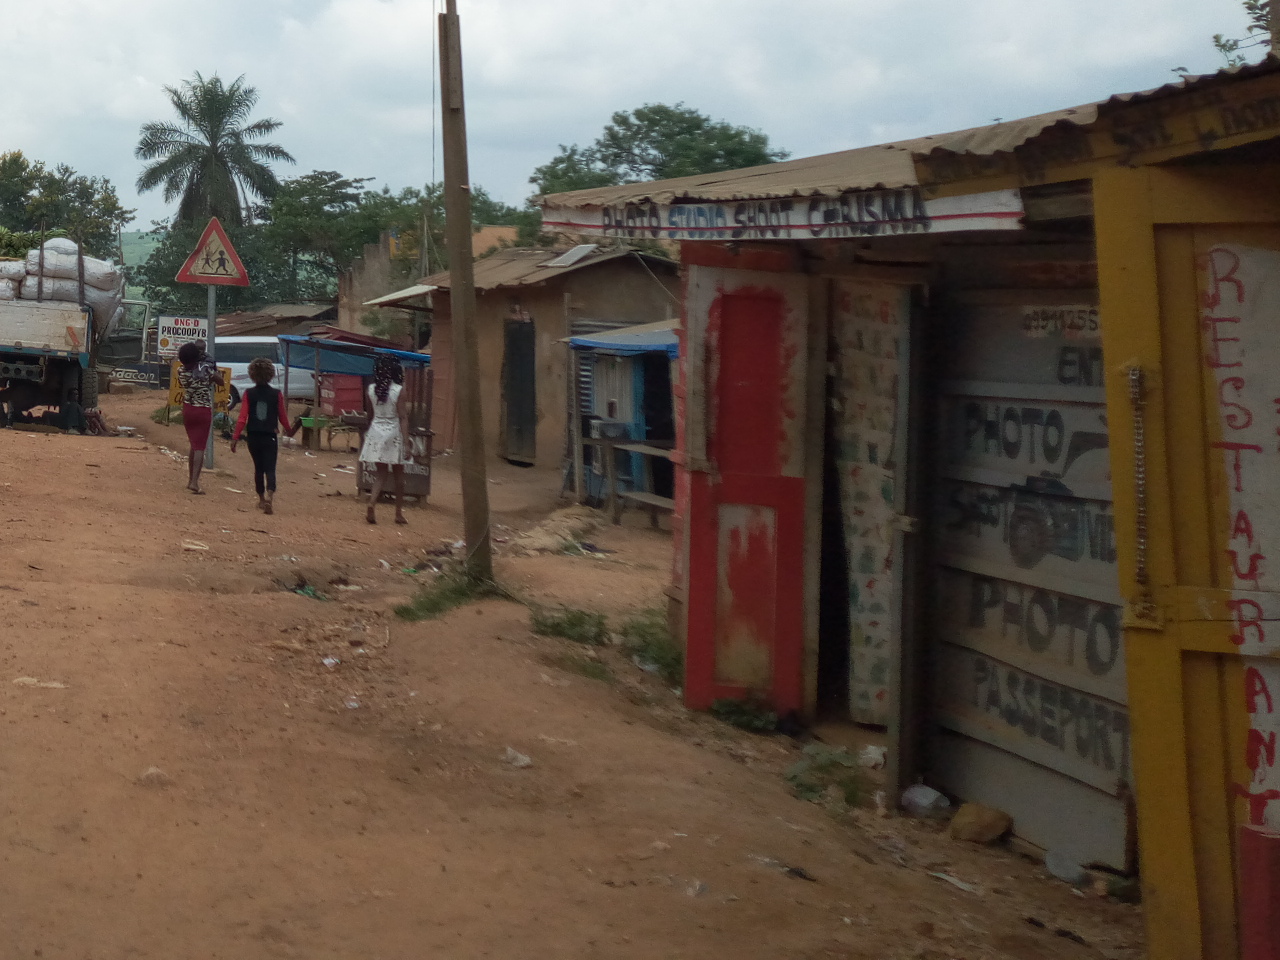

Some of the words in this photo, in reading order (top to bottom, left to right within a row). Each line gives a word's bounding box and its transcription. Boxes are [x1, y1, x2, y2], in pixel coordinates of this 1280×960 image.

[602, 205, 661, 238] PHOTO
[667, 204, 727, 238] STUDIO
[108, 370, 155, 380] odacom
[965, 401, 1065, 464] PHOTO
[1196, 246, 1280, 827] RESTAURANT
[969, 578, 1121, 675] PHOTO
